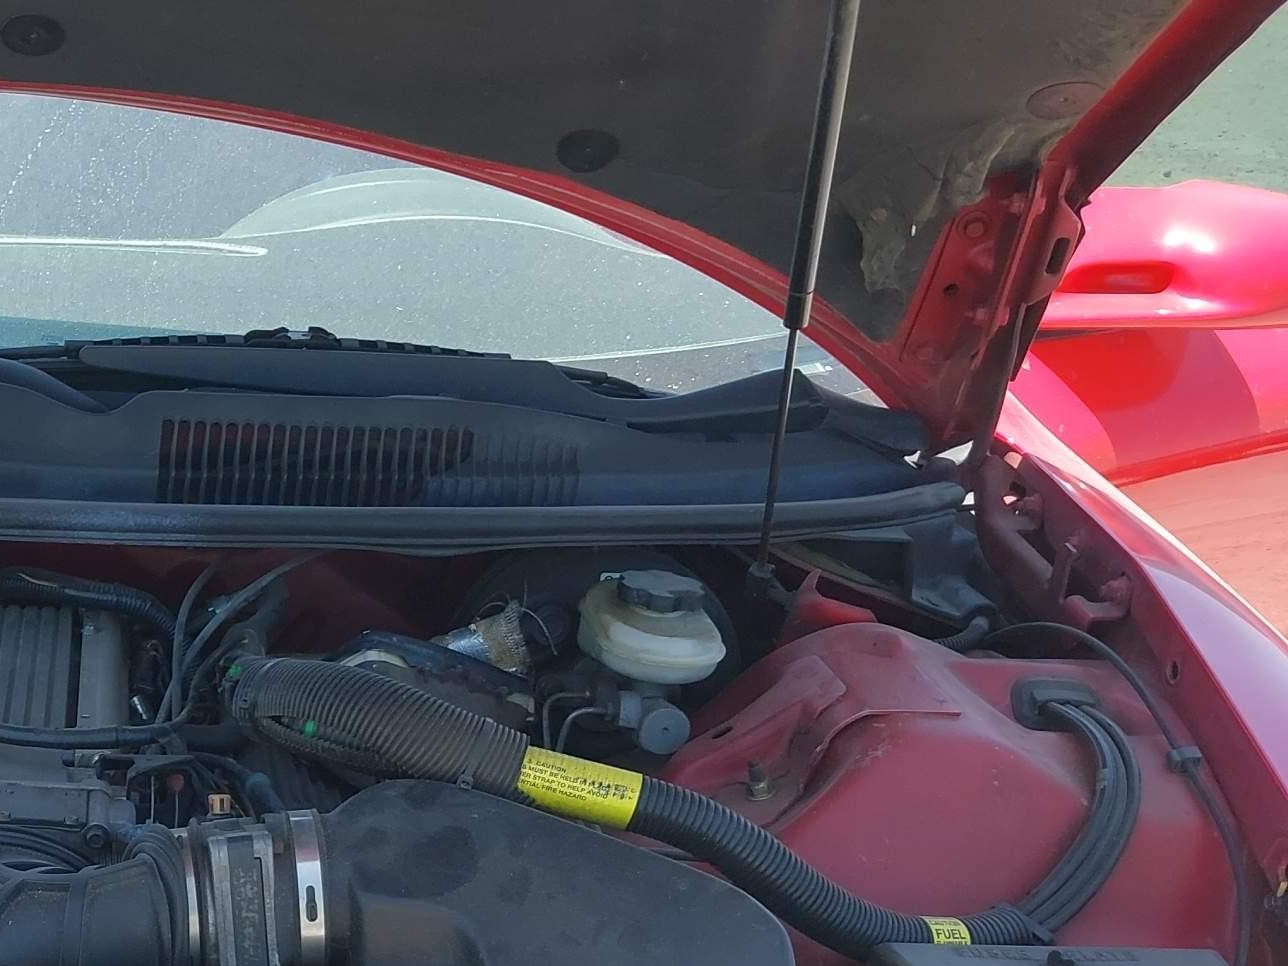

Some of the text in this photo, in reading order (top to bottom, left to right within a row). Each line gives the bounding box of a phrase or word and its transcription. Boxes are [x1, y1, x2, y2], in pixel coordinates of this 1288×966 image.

[528, 766, 548, 776] MUST
[549, 772, 559, 780] BE
[560, 774, 579, 784] HELD
[536, 760, 567, 773] CAUTION
[532, 775, 556, 787] STRAP
[557, 781, 566, 789] TO
[567, 784, 586, 793] HELP
[587, 789, 609, 800] AVOID
[541, 784, 558, 794] FIRE
[558, 789, 587, 801] HAZARD
[935, 928, 967, 940] FUEL
